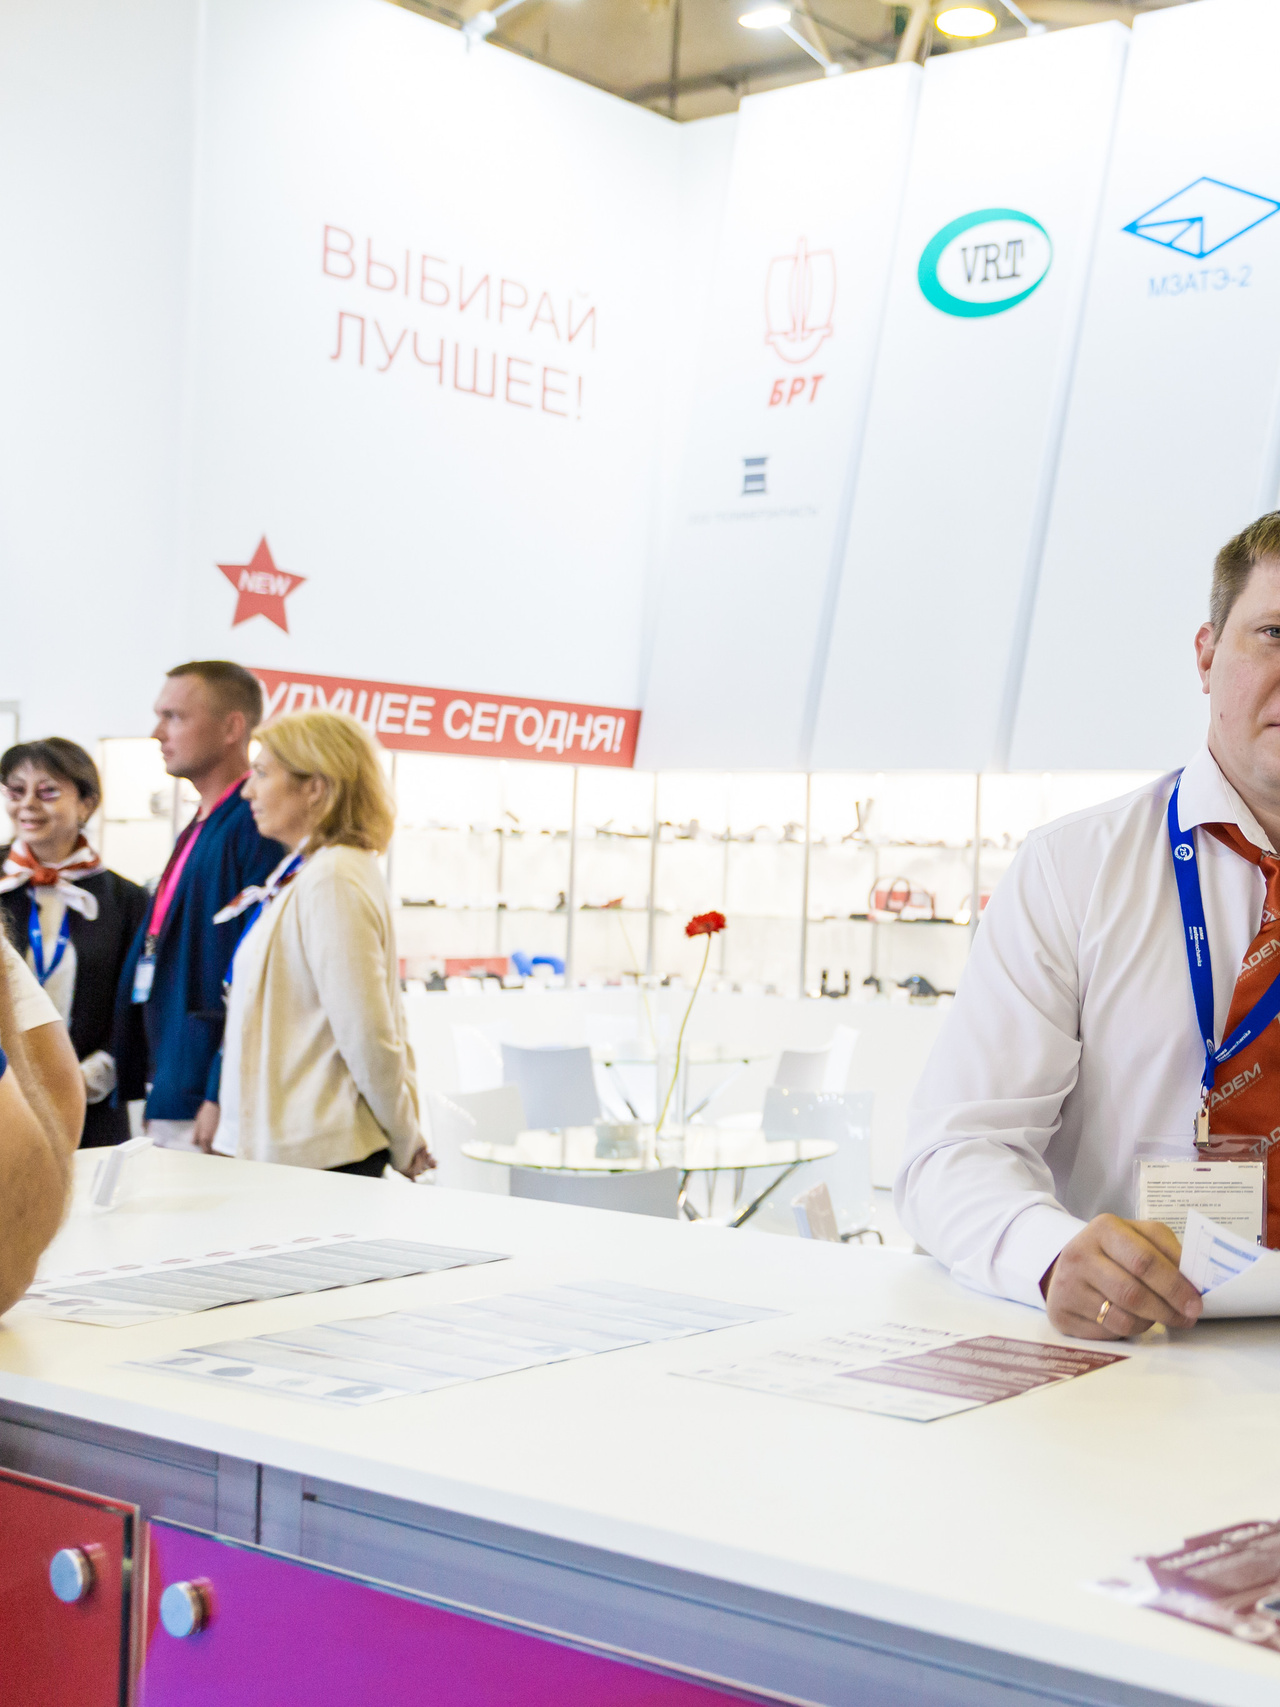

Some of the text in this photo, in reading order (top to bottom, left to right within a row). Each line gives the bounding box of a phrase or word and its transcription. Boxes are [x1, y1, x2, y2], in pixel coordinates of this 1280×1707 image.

[961, 238, 1025, 284] VRT
[1147, 265, 1254, 299] МЗАТЭ-2
[322, 223, 597, 350] ВЫБИРАЙ
[329, 310, 583, 421] ЛУЧШЕЕ!
[768, 374, 824, 407] БРТ
[237, 567, 293, 598] NEW
[258, 679, 626, 755] УДУЩЕЕ СЕГОДНЯ!
[1210, 1062, 1262, 1108] ADEM
